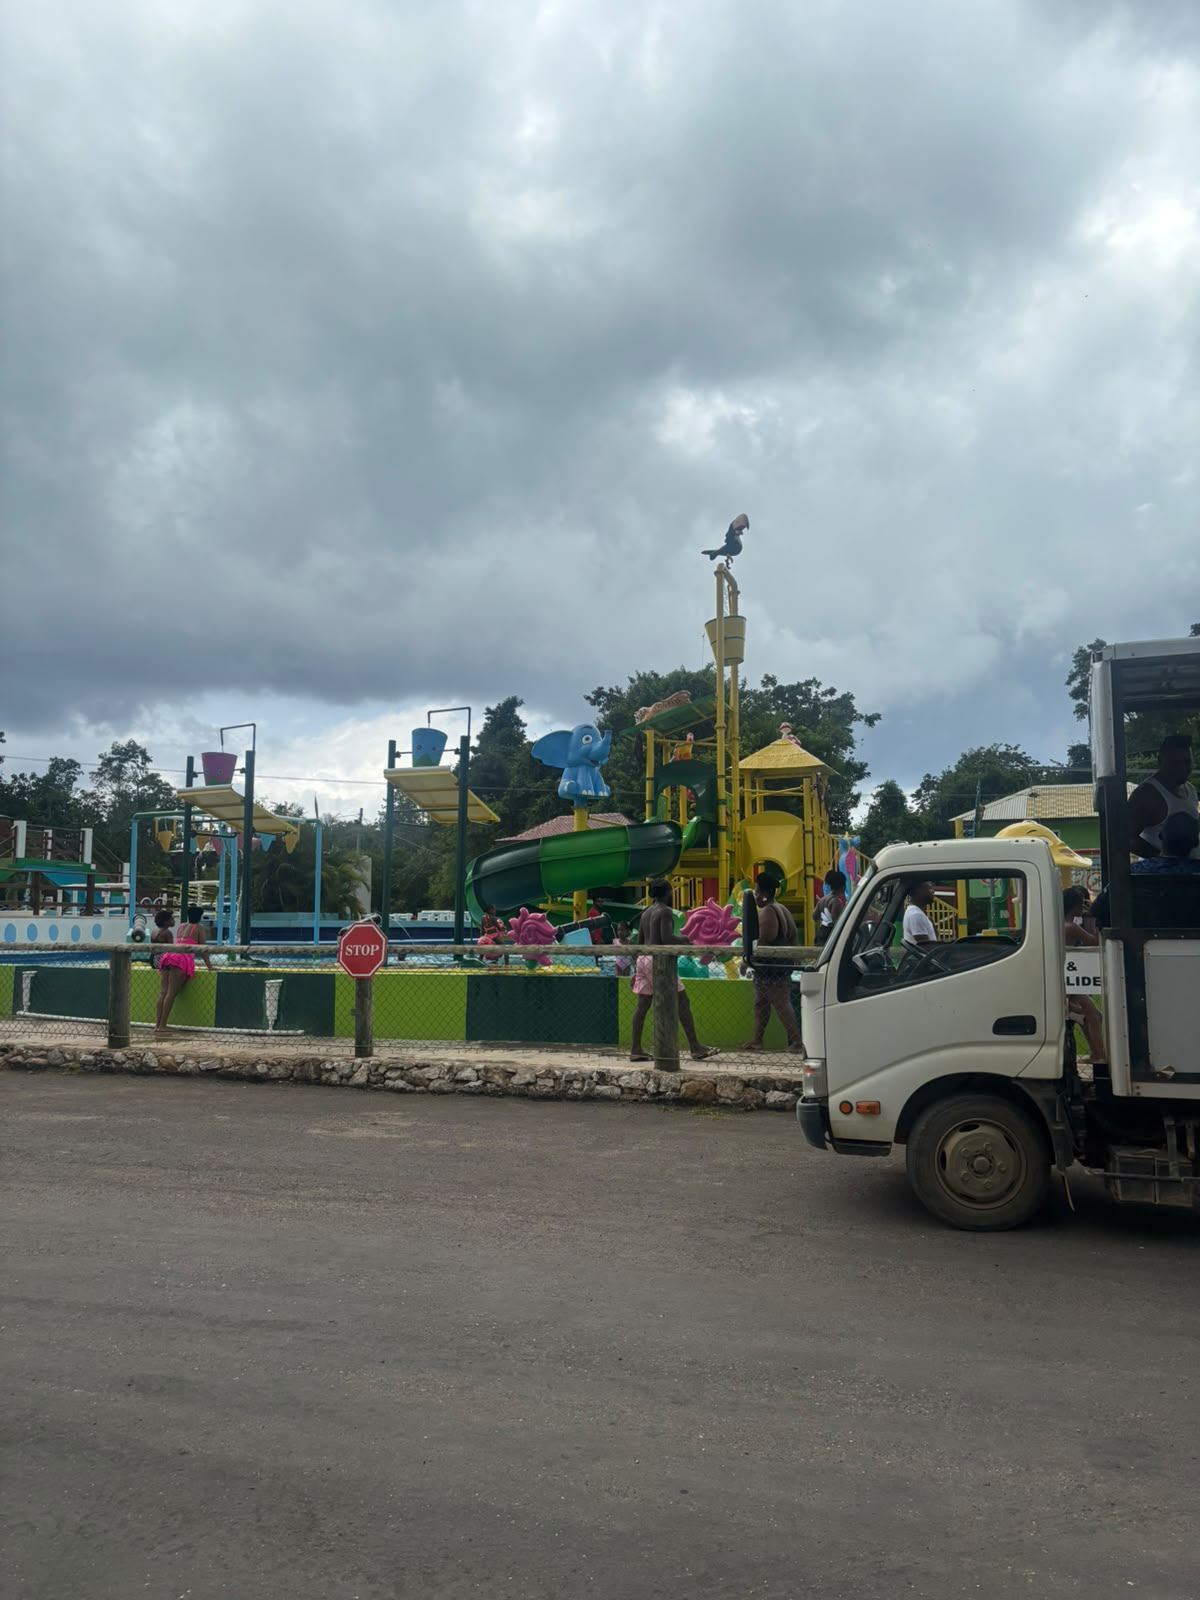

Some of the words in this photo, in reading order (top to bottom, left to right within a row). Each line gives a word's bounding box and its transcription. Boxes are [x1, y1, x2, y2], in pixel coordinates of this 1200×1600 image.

[345, 944, 380, 956] STOP
[1066, 961, 1077, 971] &
[1065, 976, 1101, 986] LIDE
